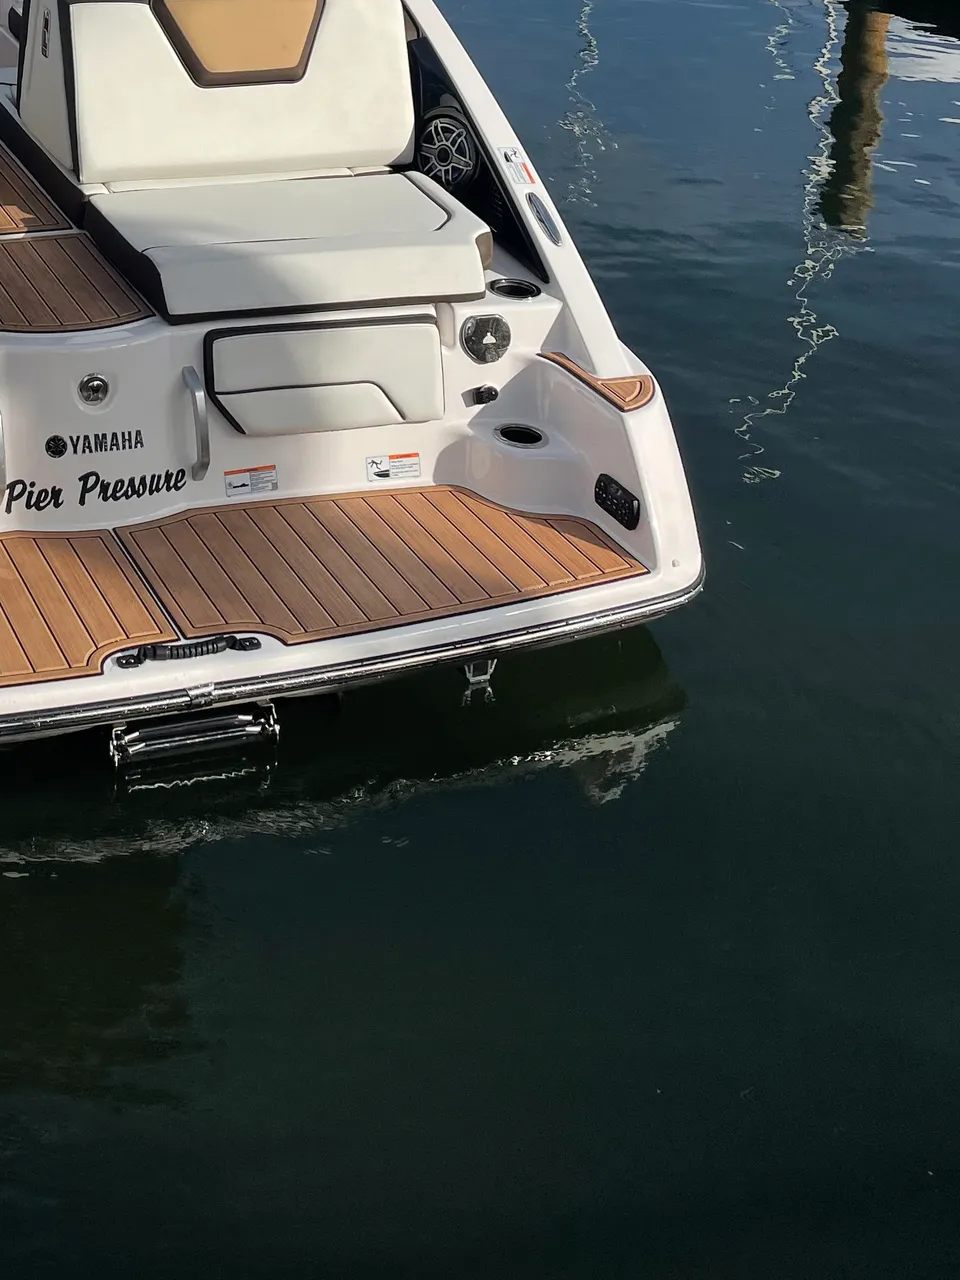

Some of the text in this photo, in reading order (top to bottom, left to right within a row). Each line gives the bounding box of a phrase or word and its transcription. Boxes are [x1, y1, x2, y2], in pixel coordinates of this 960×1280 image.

[68, 429, 145, 456] YAMAHA
[4, 479, 65, 515] Pier
[77, 468, 188, 507] Pressure
